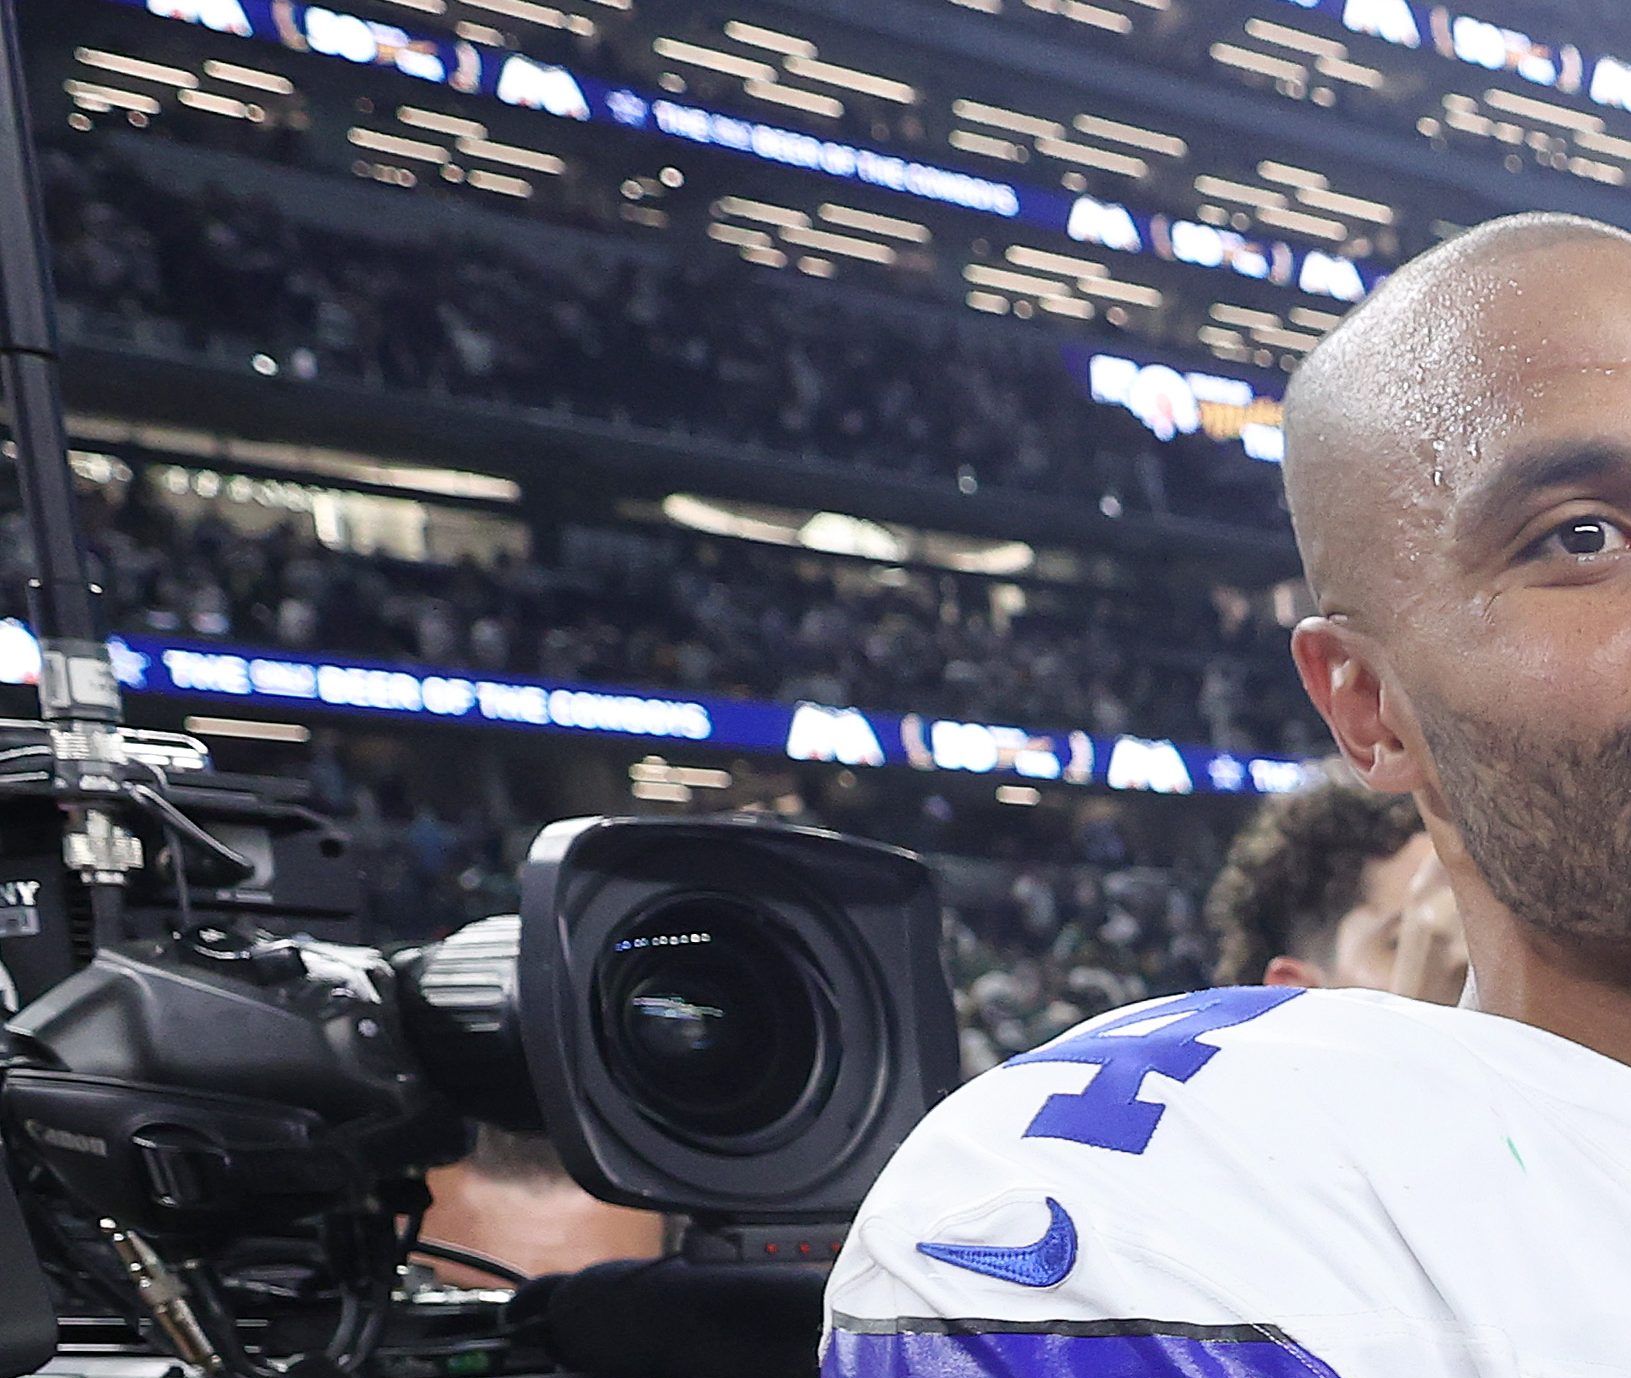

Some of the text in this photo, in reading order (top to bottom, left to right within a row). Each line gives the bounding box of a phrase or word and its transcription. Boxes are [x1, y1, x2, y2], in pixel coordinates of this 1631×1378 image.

[163, 649, 251, 694] THE
[1002, 984, 1308, 1155] 4
[24, 1118, 108, 1156] Canon
